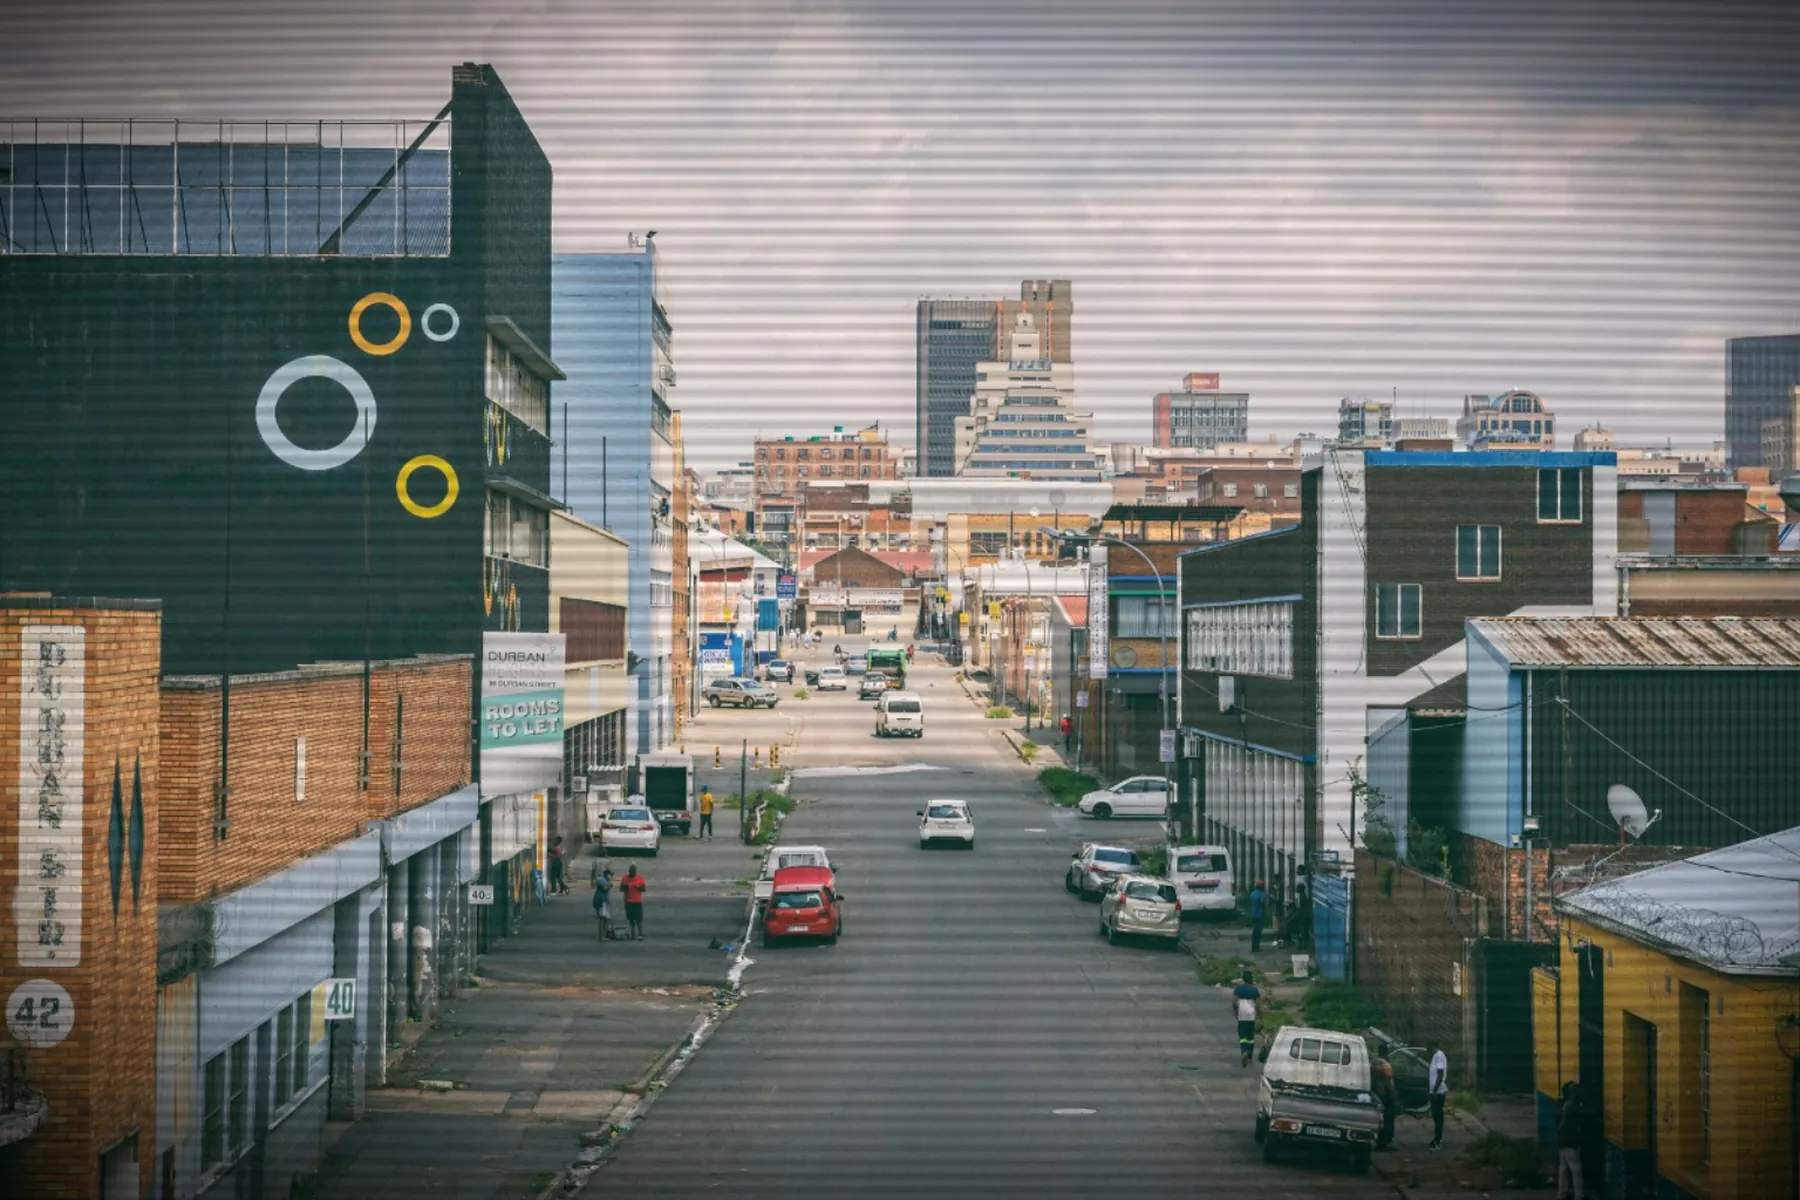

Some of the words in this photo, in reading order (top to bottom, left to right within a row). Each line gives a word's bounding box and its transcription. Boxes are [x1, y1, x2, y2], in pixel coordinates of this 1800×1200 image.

[488, 651, 545, 662] DURBAN
[486, 699, 560, 721] ROOMS
[490, 722, 517, 739] TO
[522, 718, 559, 736] LET
[327, 983, 353, 1015] 40
[15, 997, 60, 1029] 42
